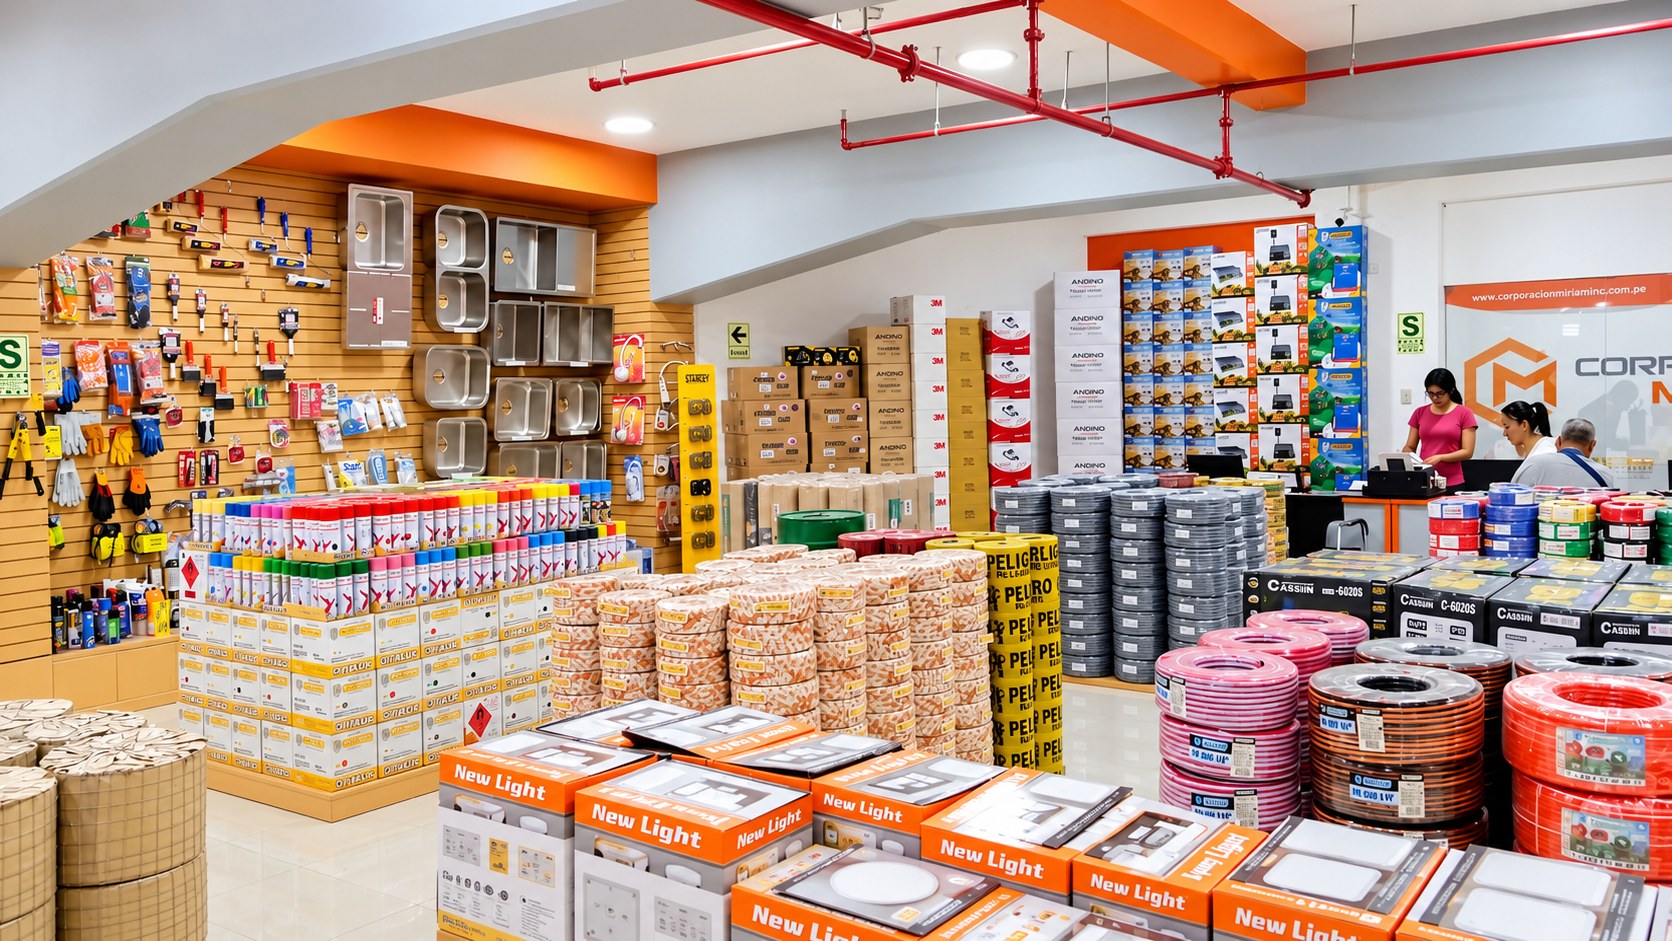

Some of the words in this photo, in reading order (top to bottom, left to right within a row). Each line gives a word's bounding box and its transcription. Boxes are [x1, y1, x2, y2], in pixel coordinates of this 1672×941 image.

[930, 299, 942, 307] 3M
[1472, 285, 1647, 302] www.corporacionmiriaminc.com.pe
[931, 328, 943, 336] 3M
[1402, 315, 1420, 337] S
[0, 339, 22, 369] S
[932, 357, 944, 365] 3M
[932, 385, 944, 393] 3M
[933, 413, 945, 421] 3M
[934, 442, 945, 450] 3M
[935, 499, 947, 507] 3M
[1441, 600, 1476, 614] C-6020S
[454, 764, 491, 786] New
[495, 773, 547, 801] Light
[823, 793, 856, 811] New
[859, 801, 903, 823] Light
[591, 803, 636, 829] New
[640, 817, 702, 850] Light
[736, 829, 765, 849] New
[768, 808, 802, 834] Light
[940, 839, 983, 863] New
[987, 850, 1045, 879] Light
[1090, 873, 1130, 896] New
[1134, 884, 1186, 910] Light
[752, 904, 805, 937] New
[1234, 907, 1287, 935] New
